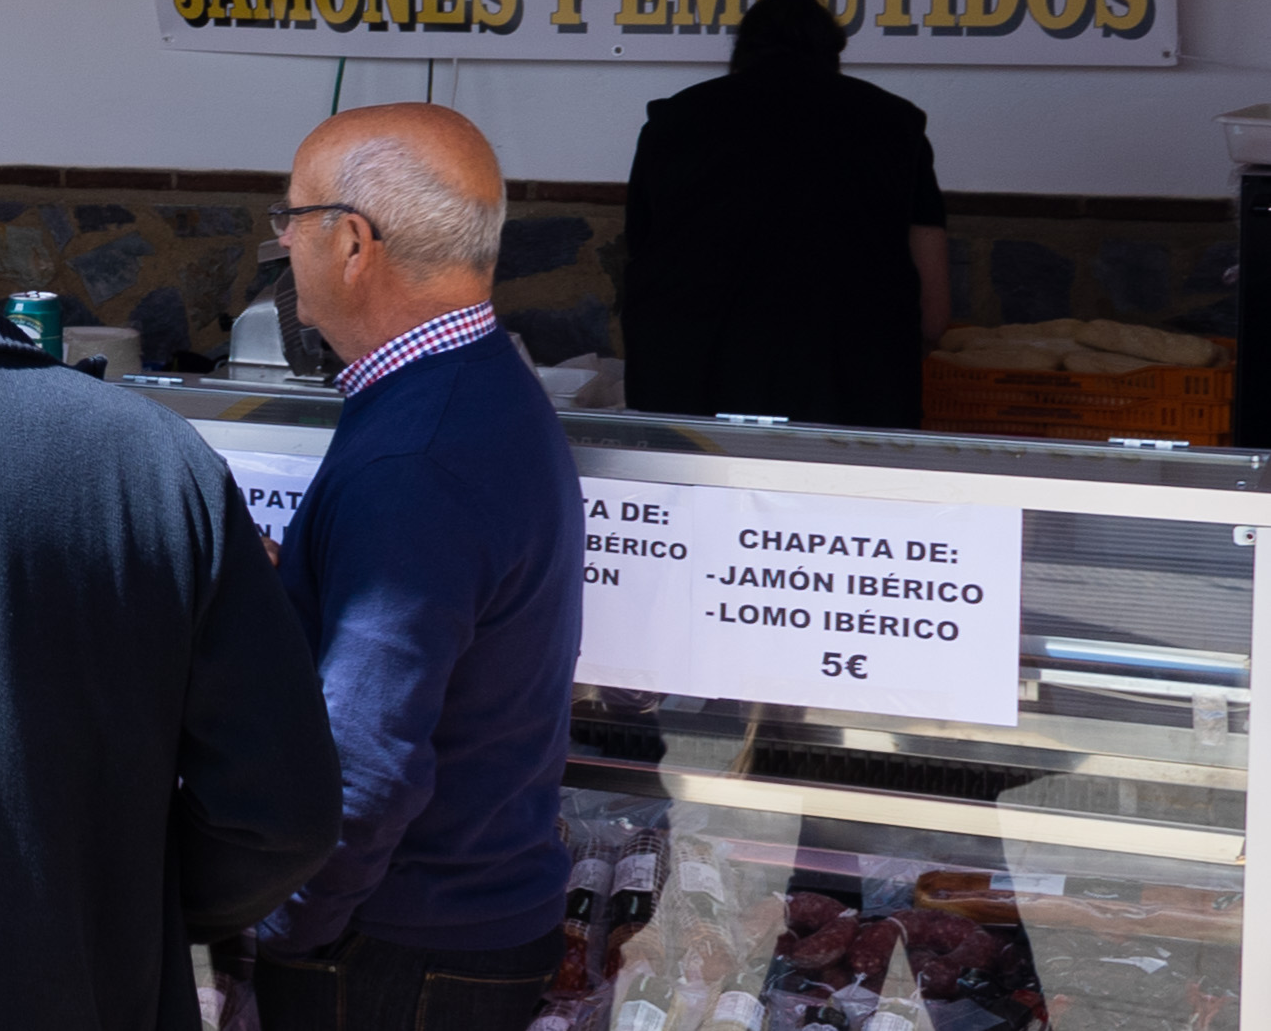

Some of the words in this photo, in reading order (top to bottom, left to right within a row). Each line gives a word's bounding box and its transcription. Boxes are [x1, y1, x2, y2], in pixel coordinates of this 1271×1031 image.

[621, 501, 669, 526] DE:
[586, 532, 687, 561] BÉRICO
[739, 528, 895, 563] CHAPATA
[906, 541, 959, 565] DE:
[847, 571, 984, 605] IBÉRICO
[824, 607, 960, 642] IBÉRICO
[821, 652, 869, 680] 5€
